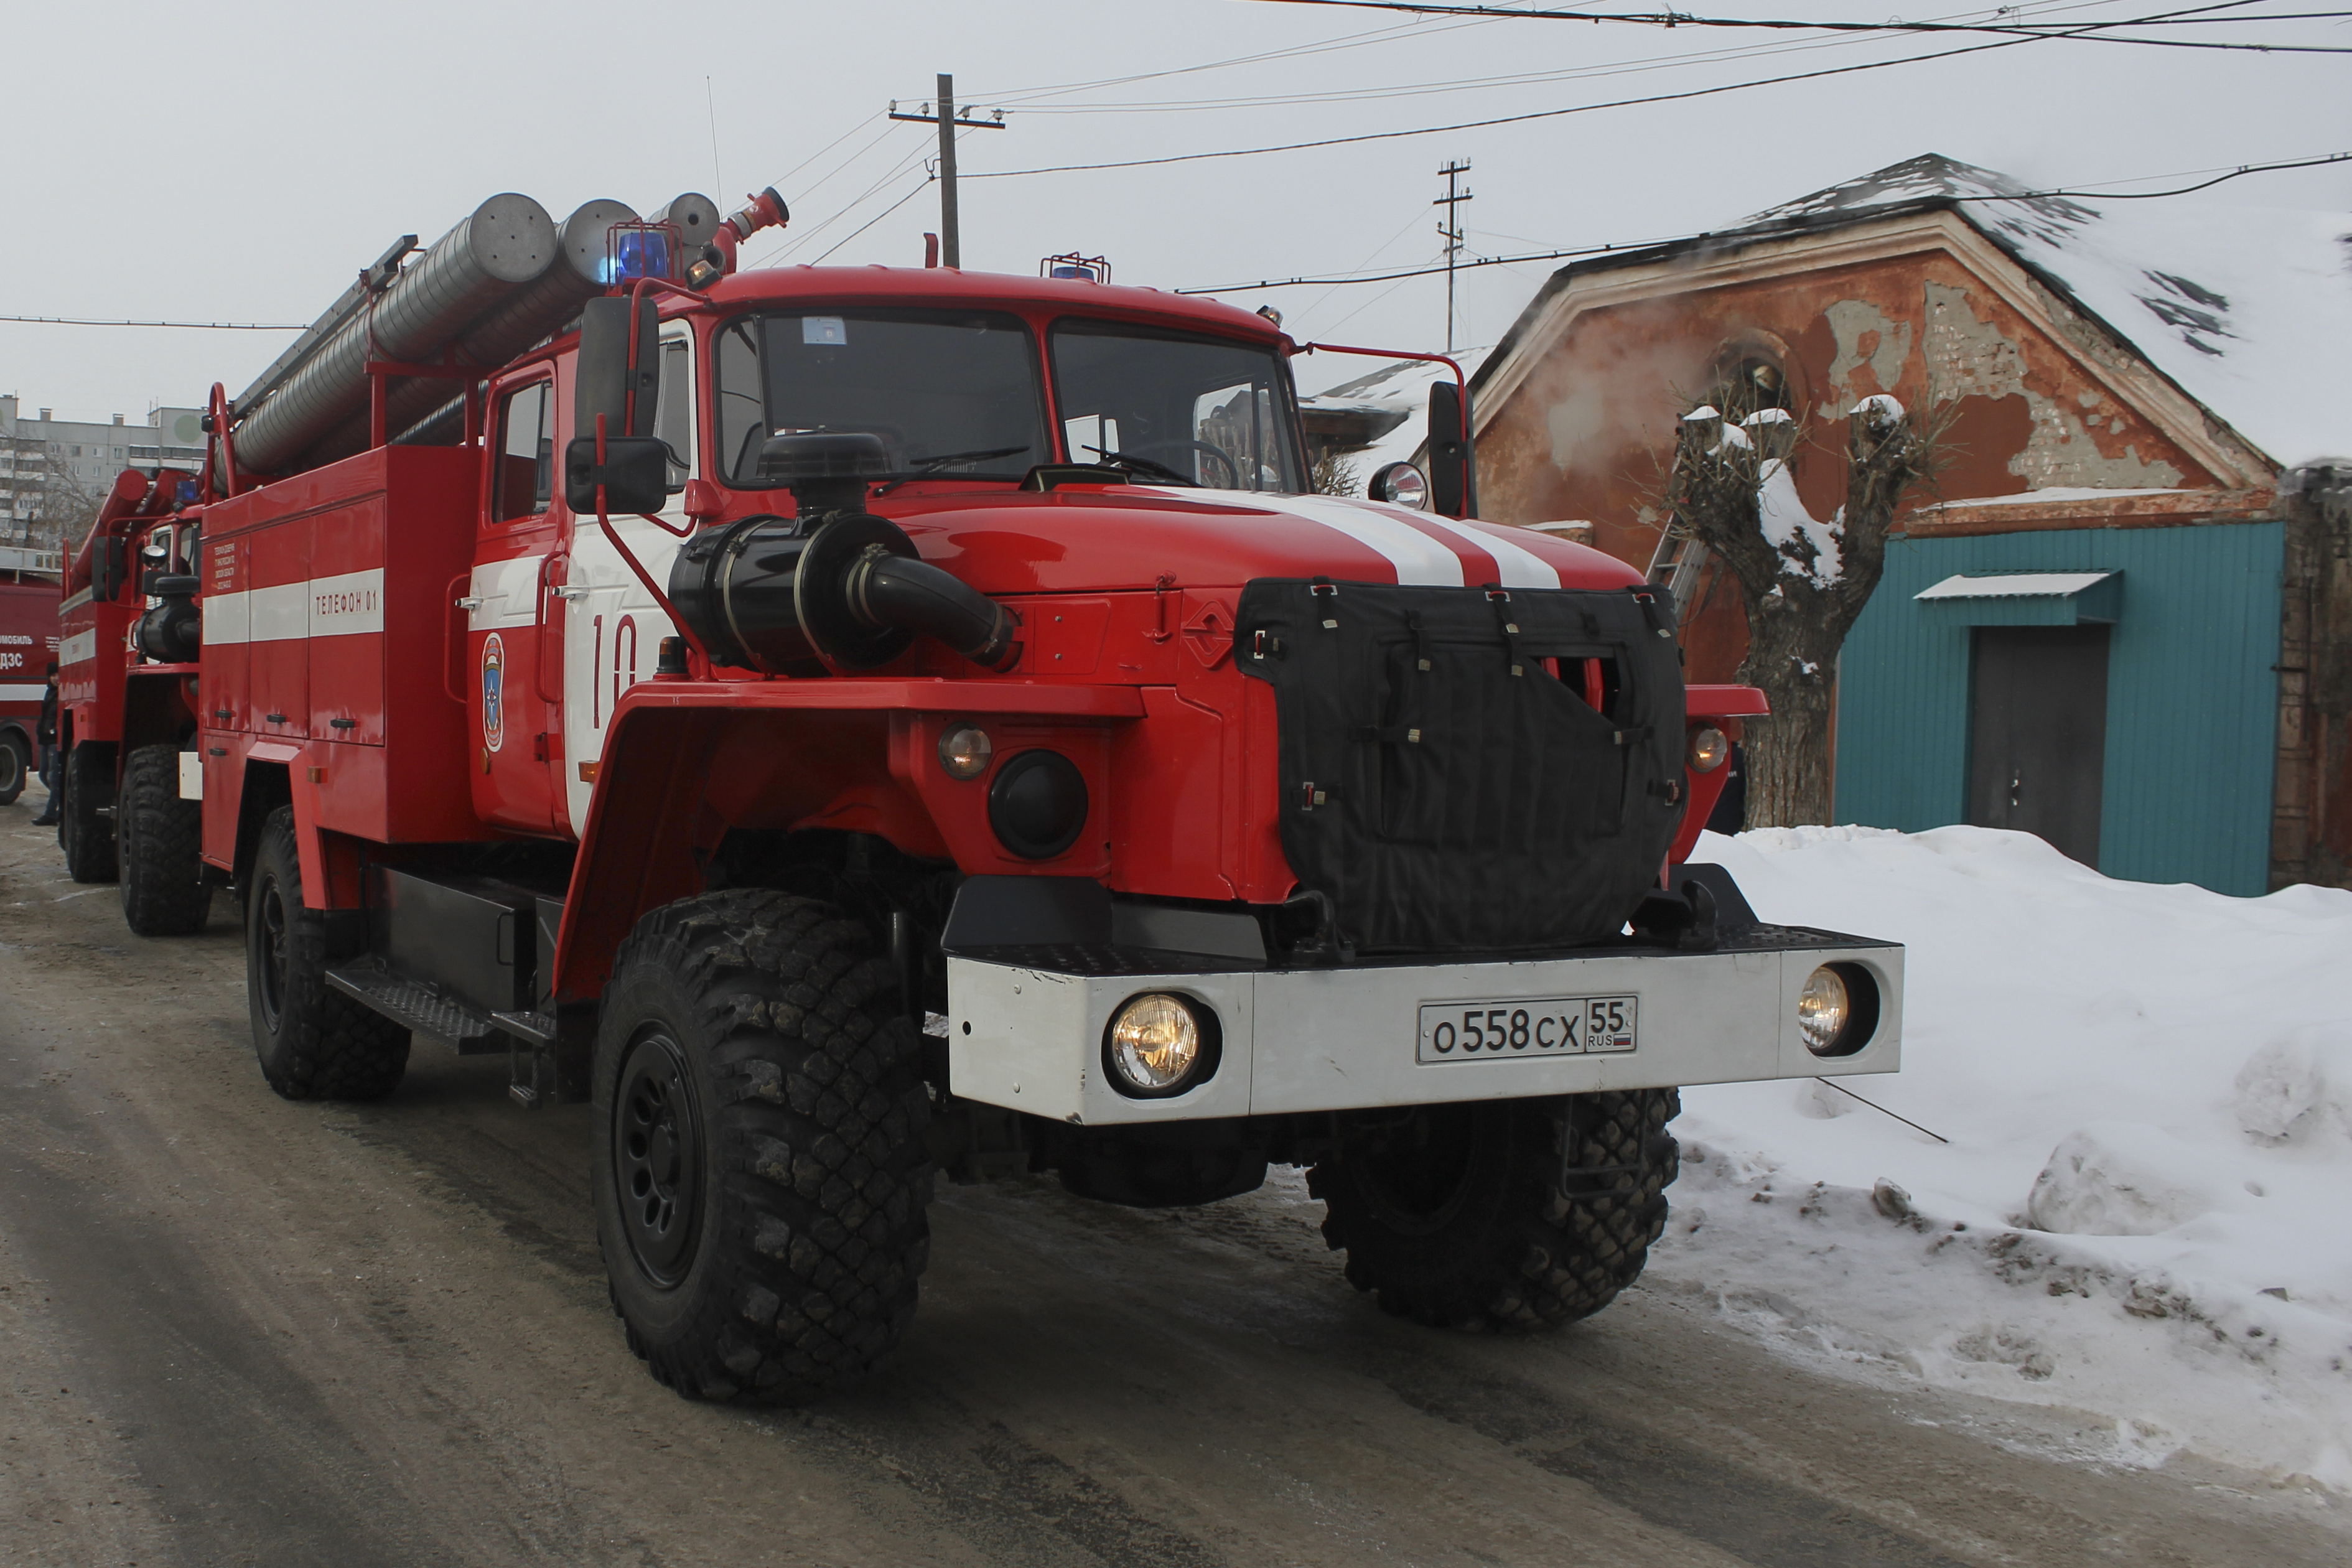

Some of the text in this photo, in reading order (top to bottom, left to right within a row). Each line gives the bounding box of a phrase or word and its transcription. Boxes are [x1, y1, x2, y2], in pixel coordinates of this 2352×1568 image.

[316, 589, 376, 615] ТЕЛЕФОН 01
[593, 614, 637, 729] 10
[1434, 1001, 1624, 1054] О558СХ 55
[1587, 1034, 1613, 1047] RUS
